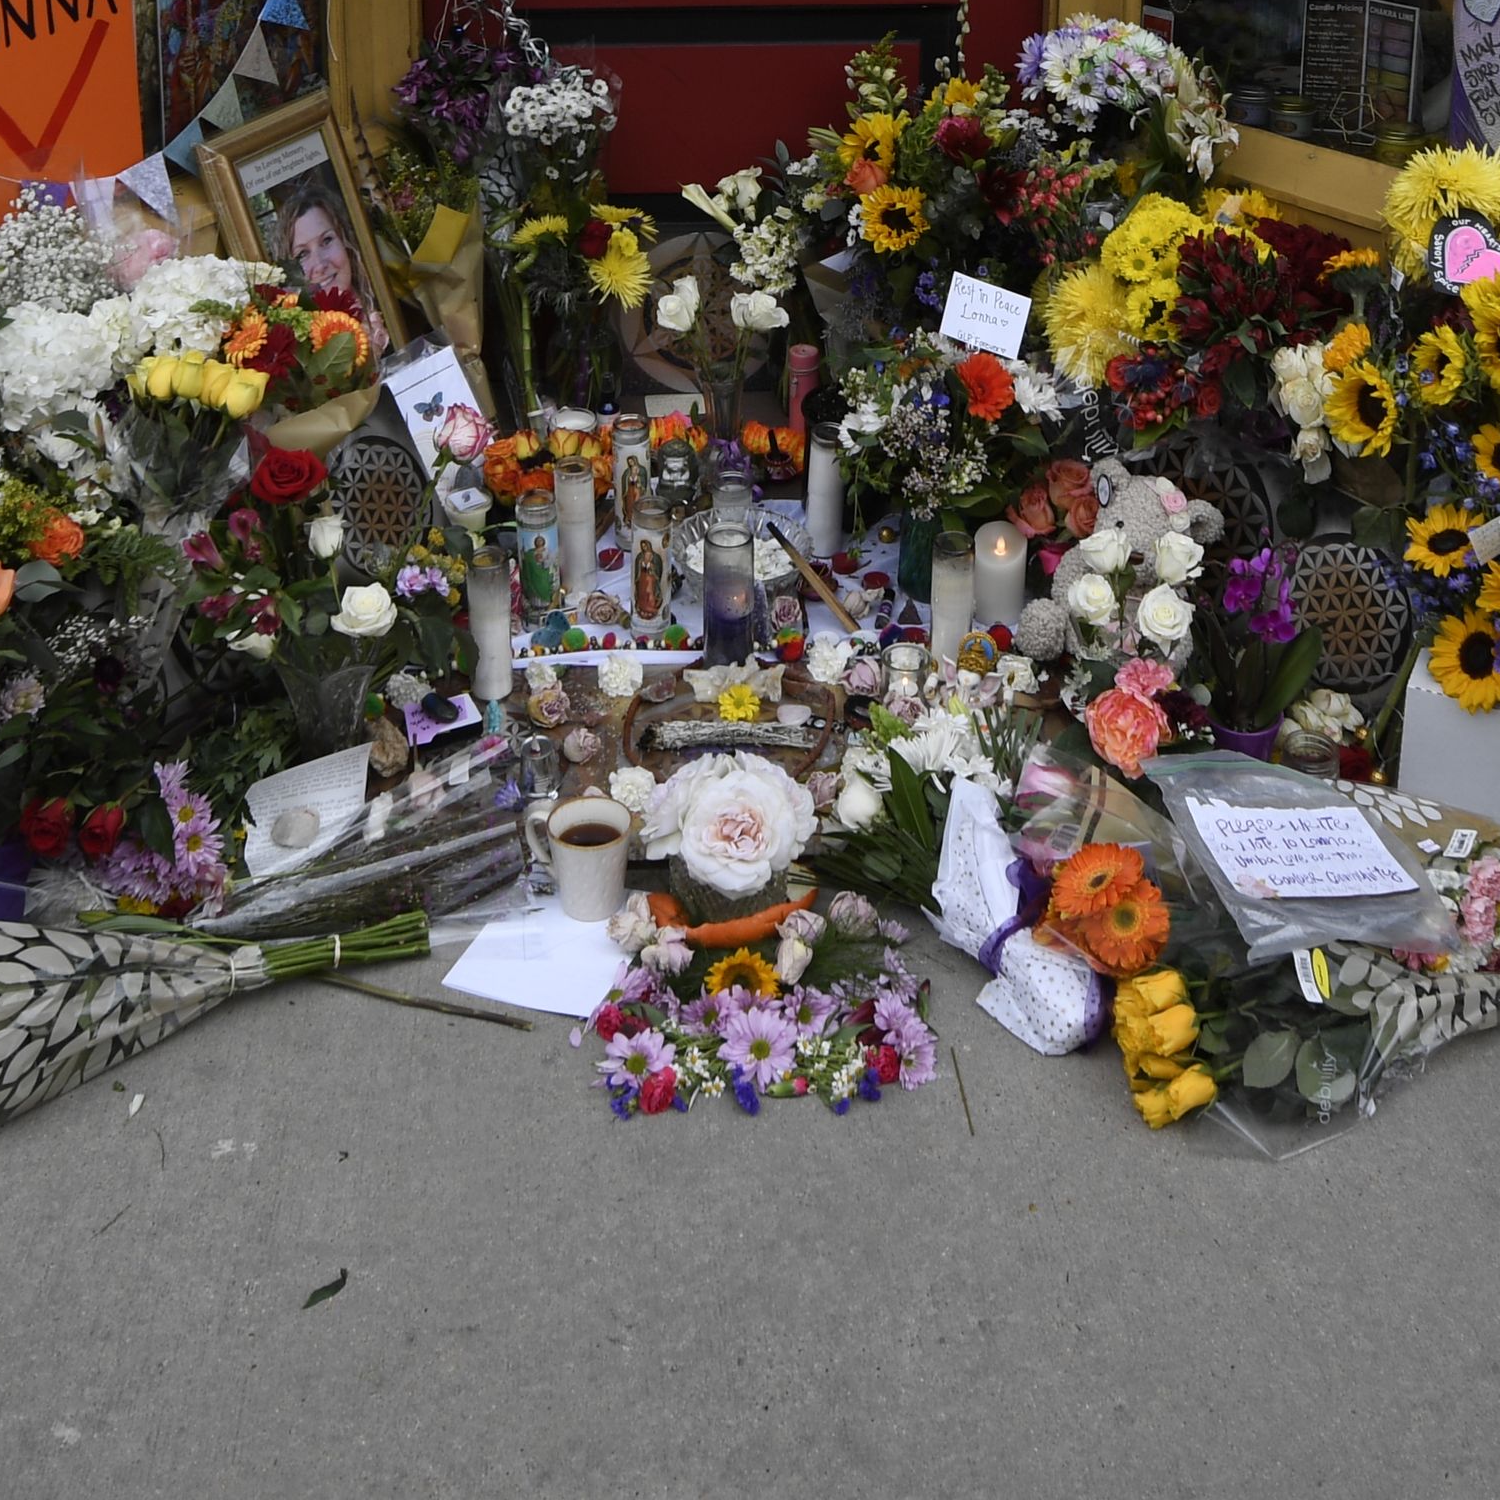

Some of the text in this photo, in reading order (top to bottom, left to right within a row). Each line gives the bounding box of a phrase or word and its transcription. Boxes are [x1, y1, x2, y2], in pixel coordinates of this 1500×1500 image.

[1308, 3, 1365, 14] Candle Pricing
[1369, 6, 1398, 19] CHAKRA
[261, 156, 282, 169] Loving
[953, 276, 1022, 317] Rest in Peace
[960, 303, 998, 326] Lonna
[1316, 1080, 1332, 1125] debi
